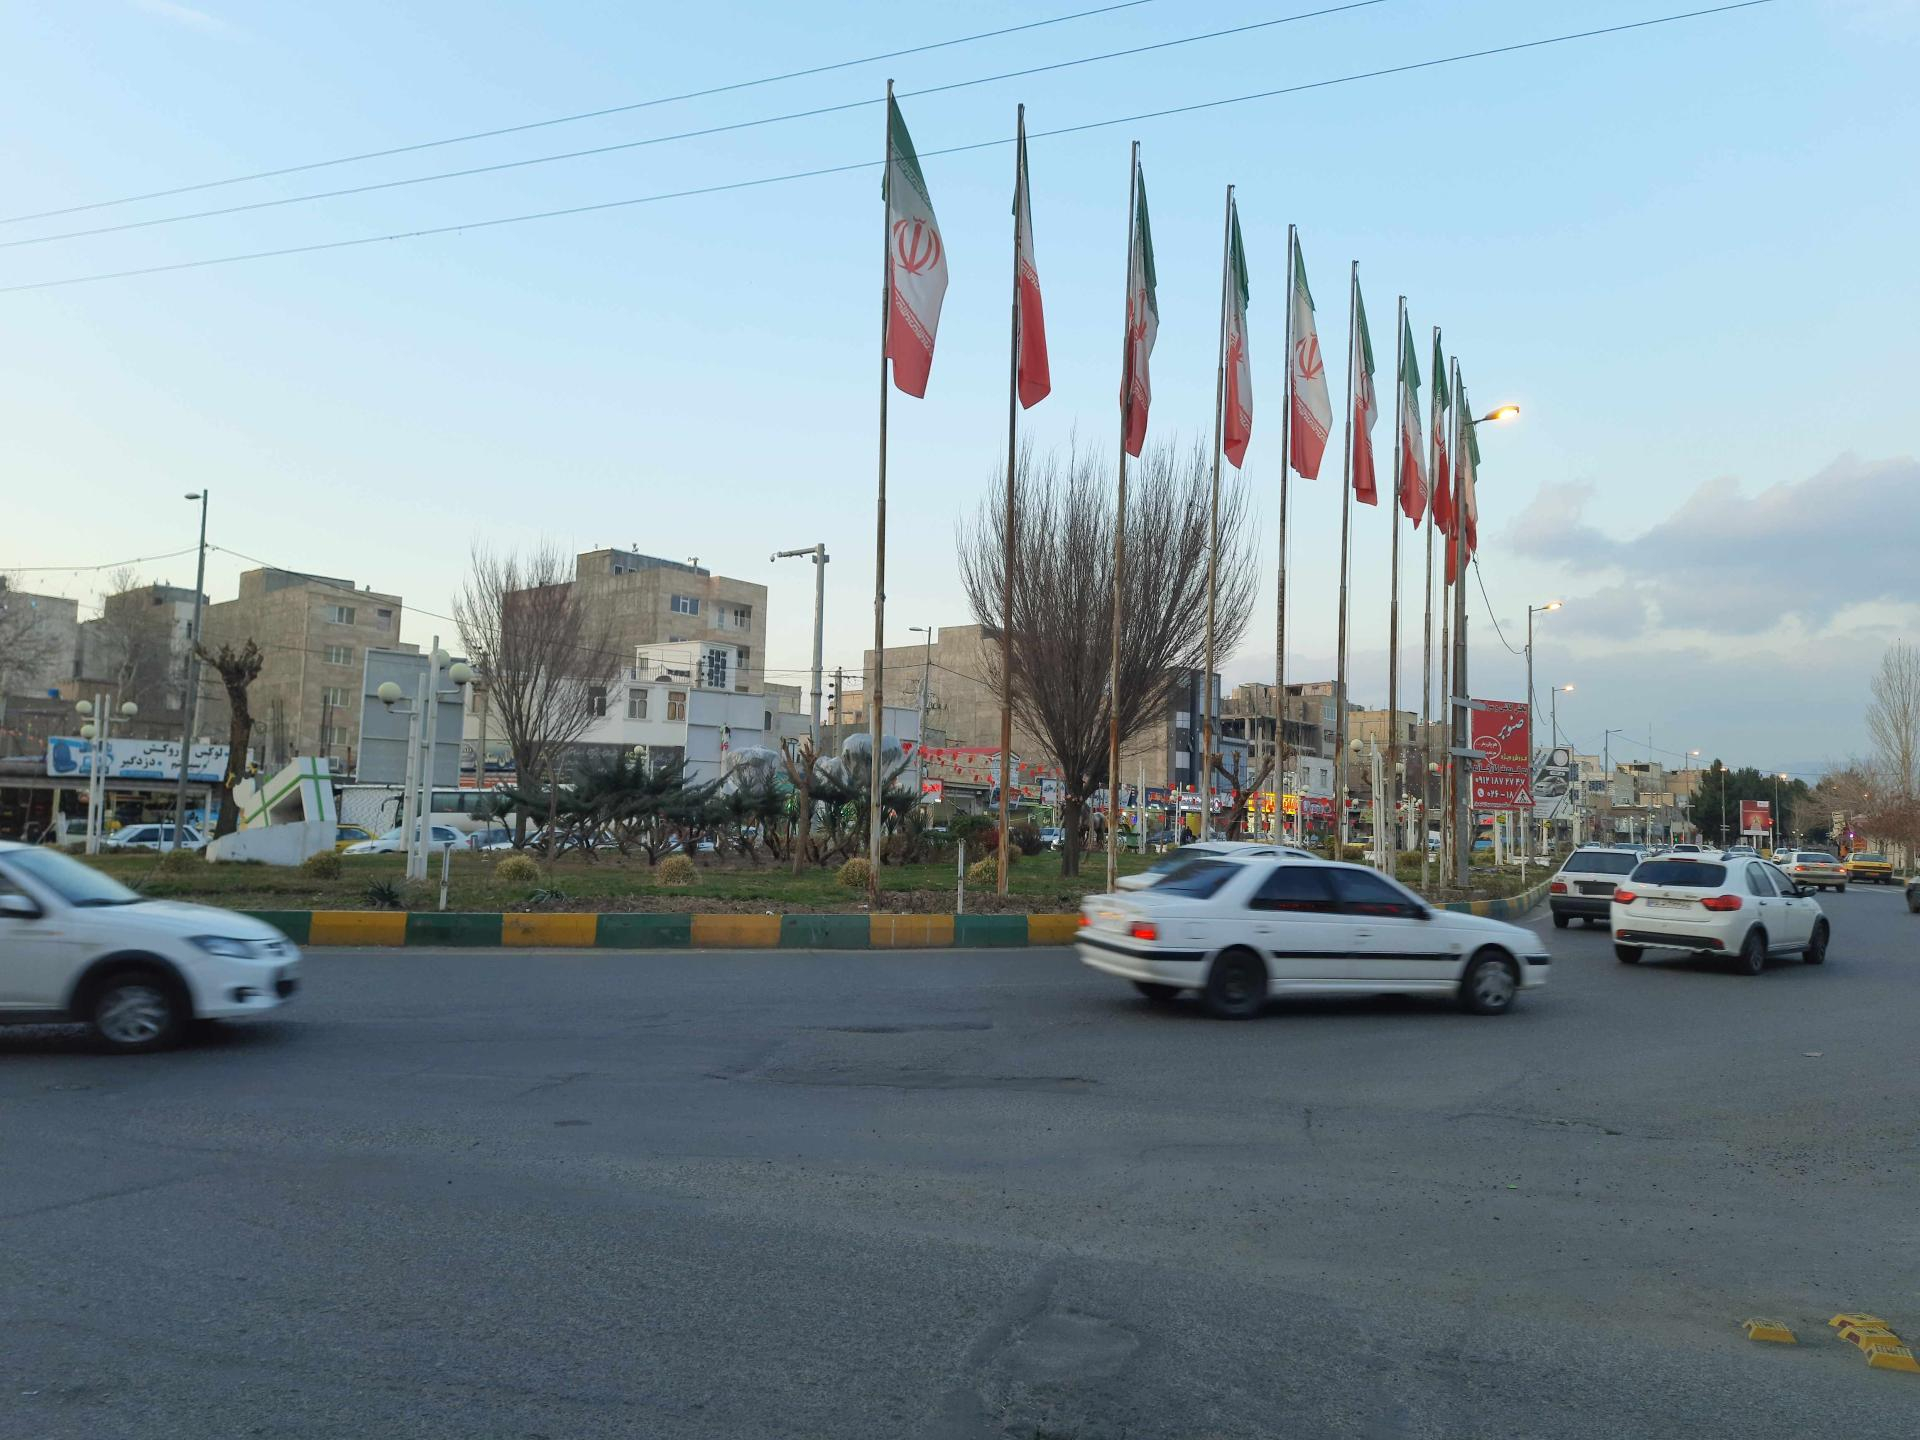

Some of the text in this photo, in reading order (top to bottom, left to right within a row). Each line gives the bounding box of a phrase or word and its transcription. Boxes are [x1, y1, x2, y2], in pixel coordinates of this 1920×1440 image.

[1497, 714, 1524, 740] صنوبر
[143, 744, 179, 757] روکش
[120, 757, 155, 768] دزدگیر
